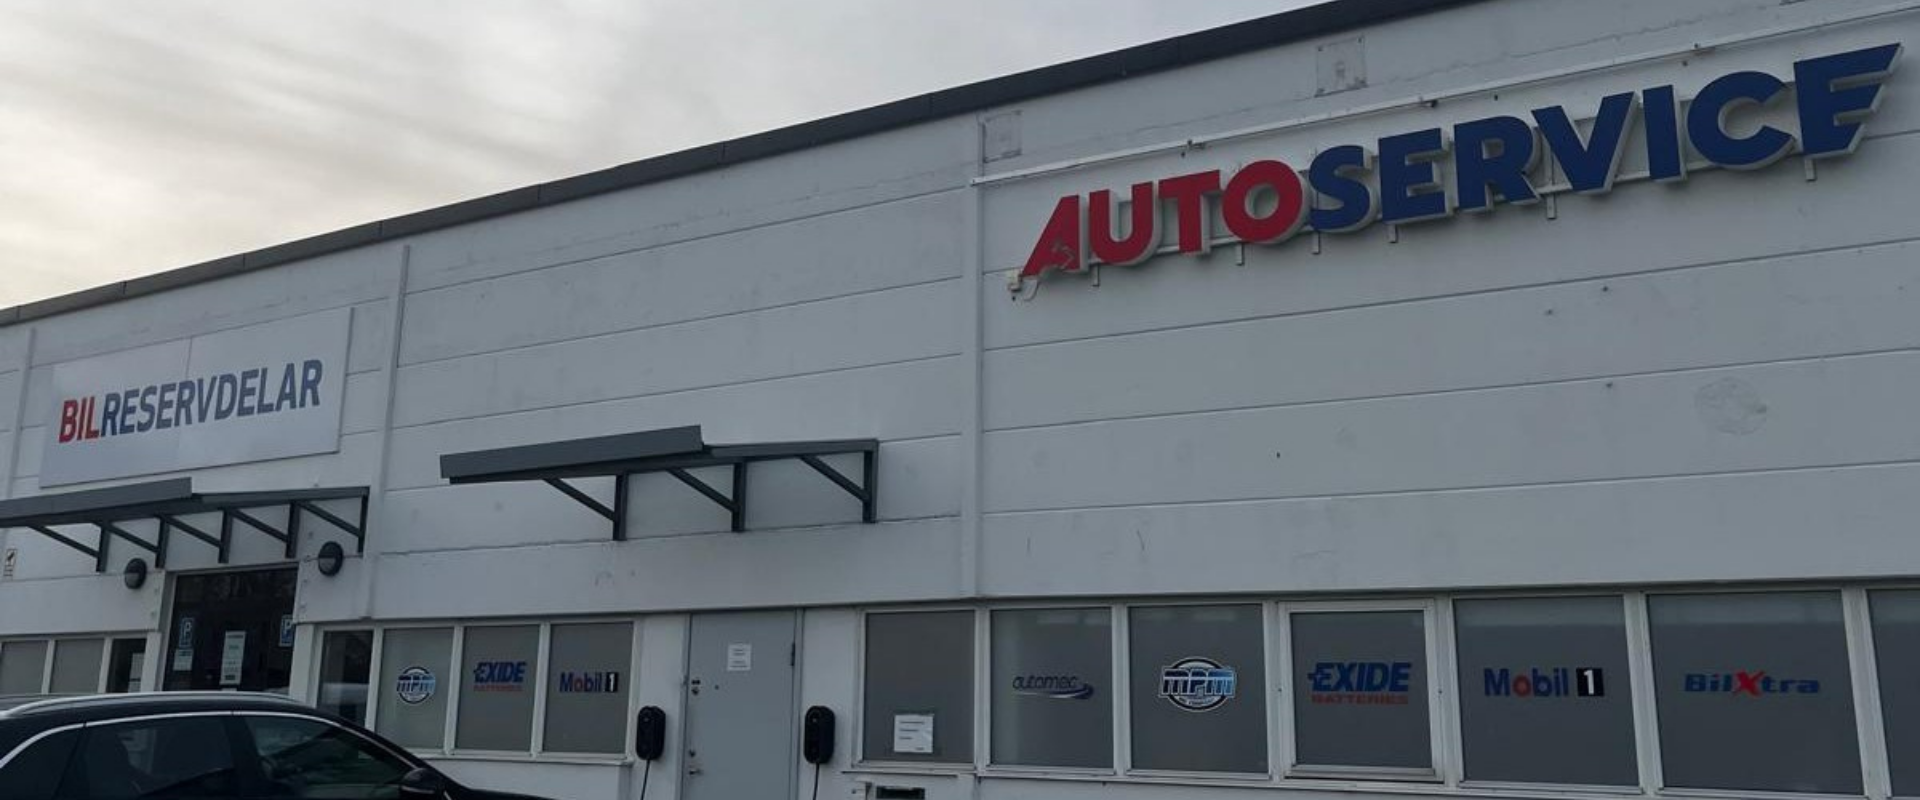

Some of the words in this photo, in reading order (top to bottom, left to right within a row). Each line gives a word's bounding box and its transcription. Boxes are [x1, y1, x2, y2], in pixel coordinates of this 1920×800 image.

[1021, 43, 1903, 279] AUTOSERVICE
[59, 359, 323, 443] BILRESERVDELAR
[473, 661, 527, 683] EXIDE
[559, 672, 602, 693] Mobil
[1012, 675, 1079, 690] automec
[1307, 662, 1412, 692] EXIDE
[1484, 668, 1569, 697] Mobil
[1581, 668, 1598, 696] 1
[1684, 670, 1821, 697] BilXtra
